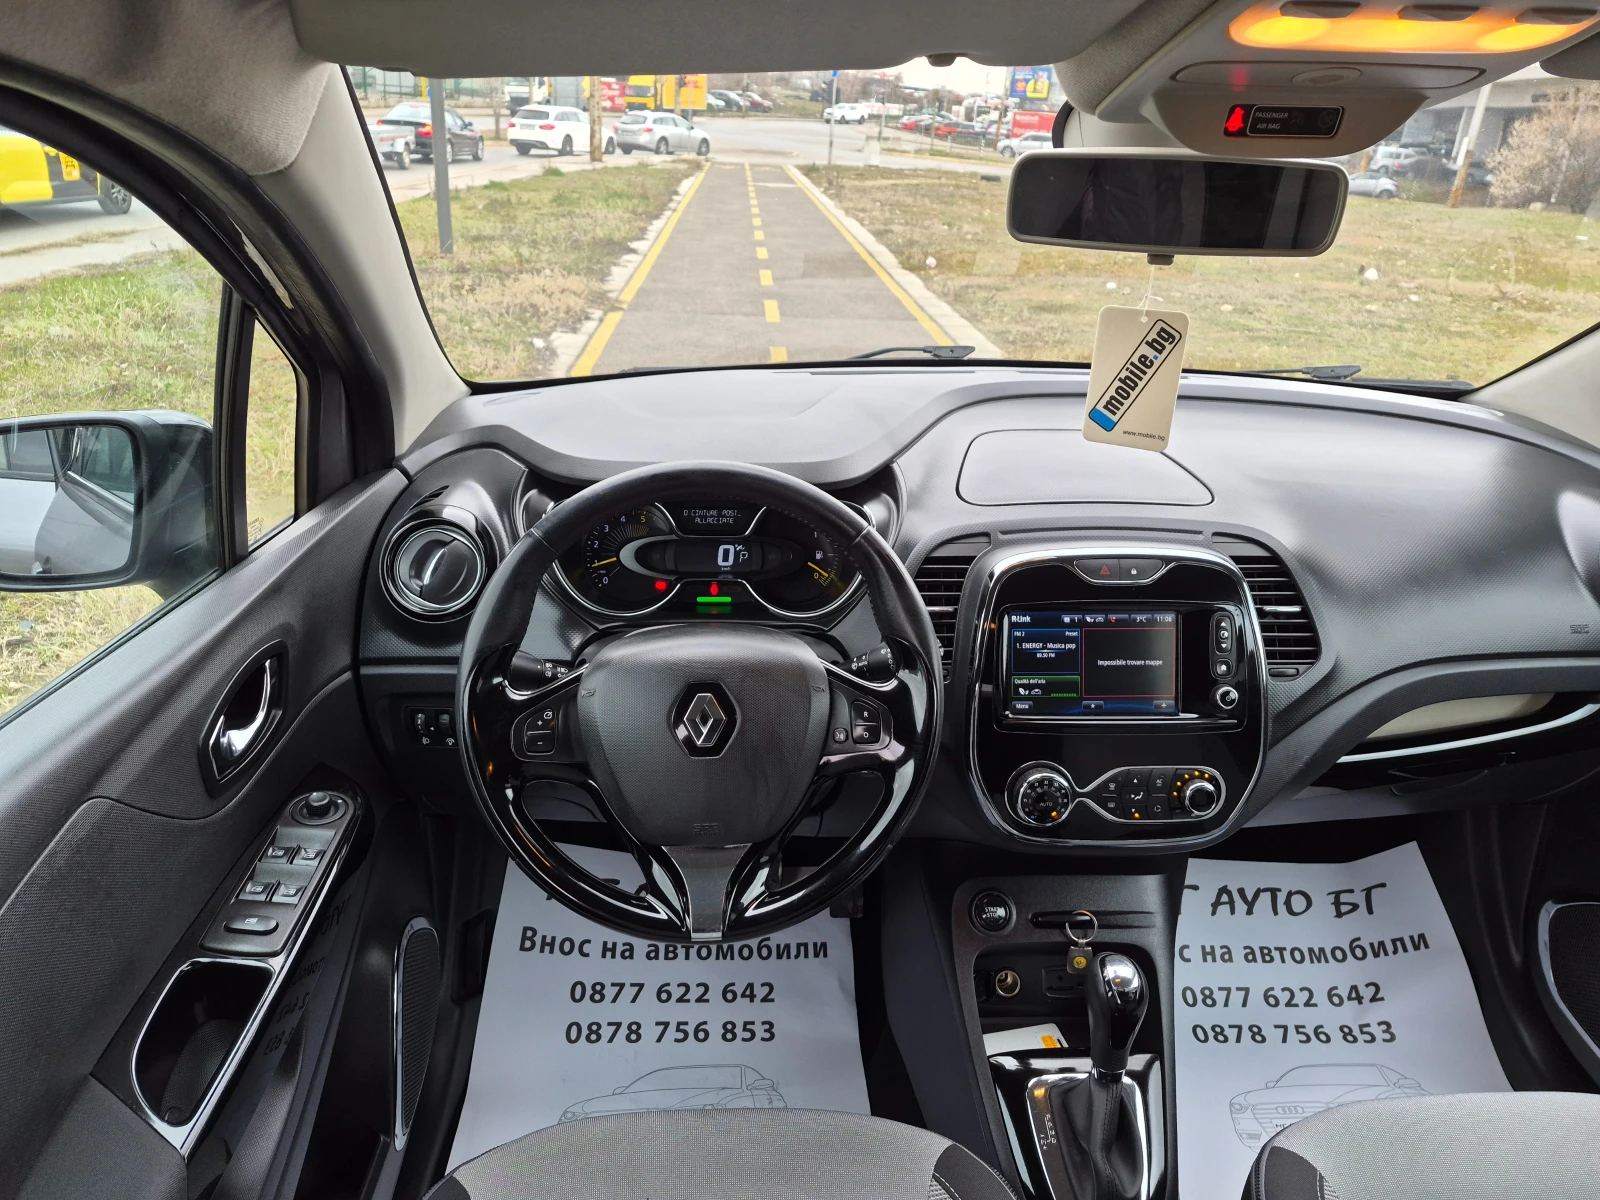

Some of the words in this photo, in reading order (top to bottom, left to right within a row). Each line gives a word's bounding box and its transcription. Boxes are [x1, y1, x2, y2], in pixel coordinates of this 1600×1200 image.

[1254, 111, 1289, 119] PASSENGER
[1256, 122, 1267, 130] AIR
[1102, 326, 1176, 417] mobile.bg
[1122, 429, 1166, 442] www.mobile.bg
[603, 524, 609, 532] 3
[640, 515, 646, 523] 5
[593, 540, 599, 548] 2
[717, 544, 735, 567] 0
[602, 576, 609, 584] 0
[1097, 659, 1126, 667] Impossibile
[1145, 659, 1163, 667] mappe
[1326, 881, 1388, 919] БГ
[518, 925, 592, 958] Внос
[600, 940, 635, 961] на
[645, 936, 829, 962] автомобили
[1200, 944, 1234, 963] на
[1242, 932, 1431, 965] автомобили
[569, 980, 646, 1004] 0877
[655, 982, 710, 1004] 622
[721, 981, 776, 1004] 642
[1181, 986, 1250, 1008] 0877
[1263, 986, 1318, 1008] 622
[1326, 981, 1386, 1008] 642
[565, 1020, 642, 1045] 0878
[654, 1020, 710, 1043] 756
[720, 1020, 777, 1043] 853
[1191, 1024, 1267, 1044] 0878
[1273, 1024, 1332, 1044] 756
[1338, 1020, 1396, 1044] 853
